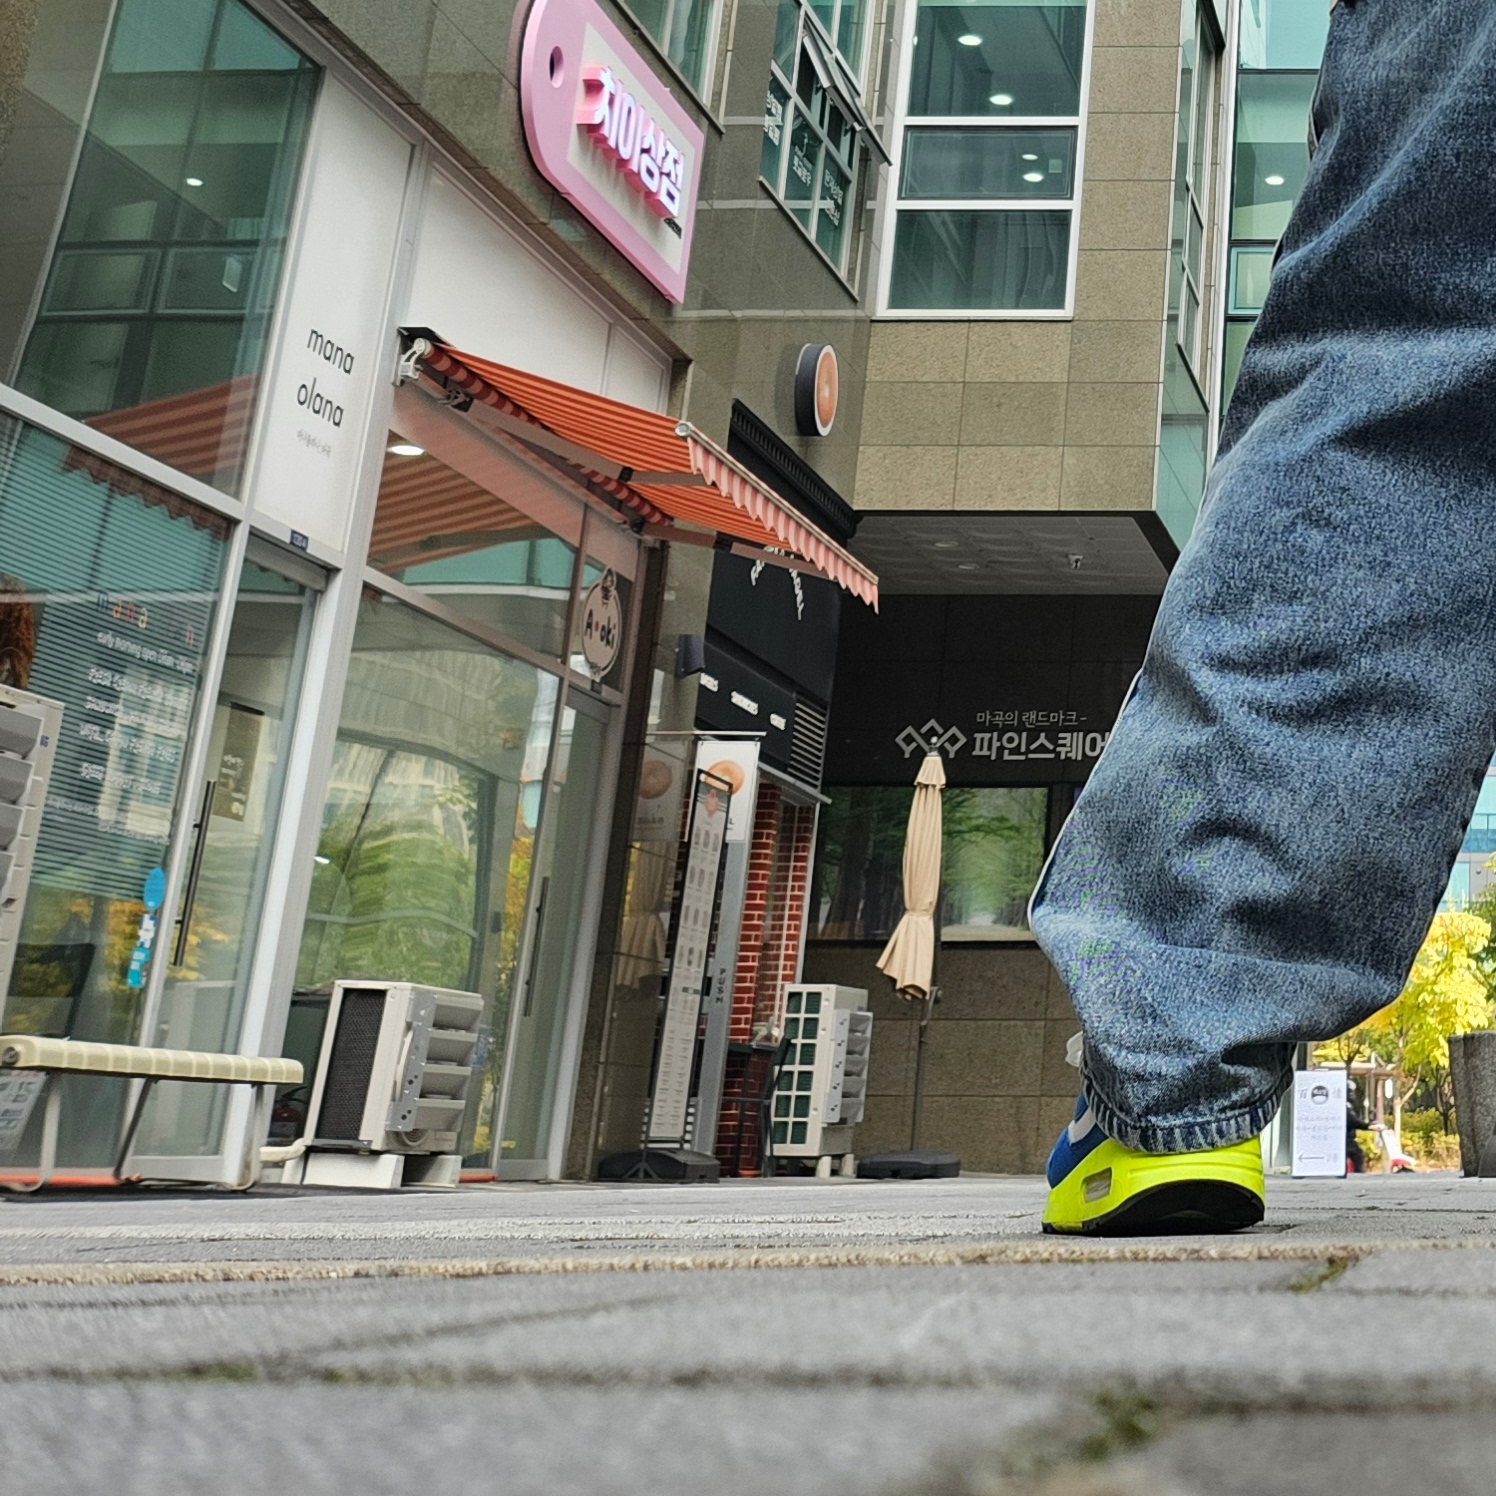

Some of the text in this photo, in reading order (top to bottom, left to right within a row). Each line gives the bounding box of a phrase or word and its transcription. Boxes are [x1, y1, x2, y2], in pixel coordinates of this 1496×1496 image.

[592, 65, 685, 218] 치이상점
[307, 328, 355, 375] mana
[297, 377, 344, 428] olana
[976, 710, 1018, 728] 마곡의
[971, 731, 1111, 761] 파인스퀘어
